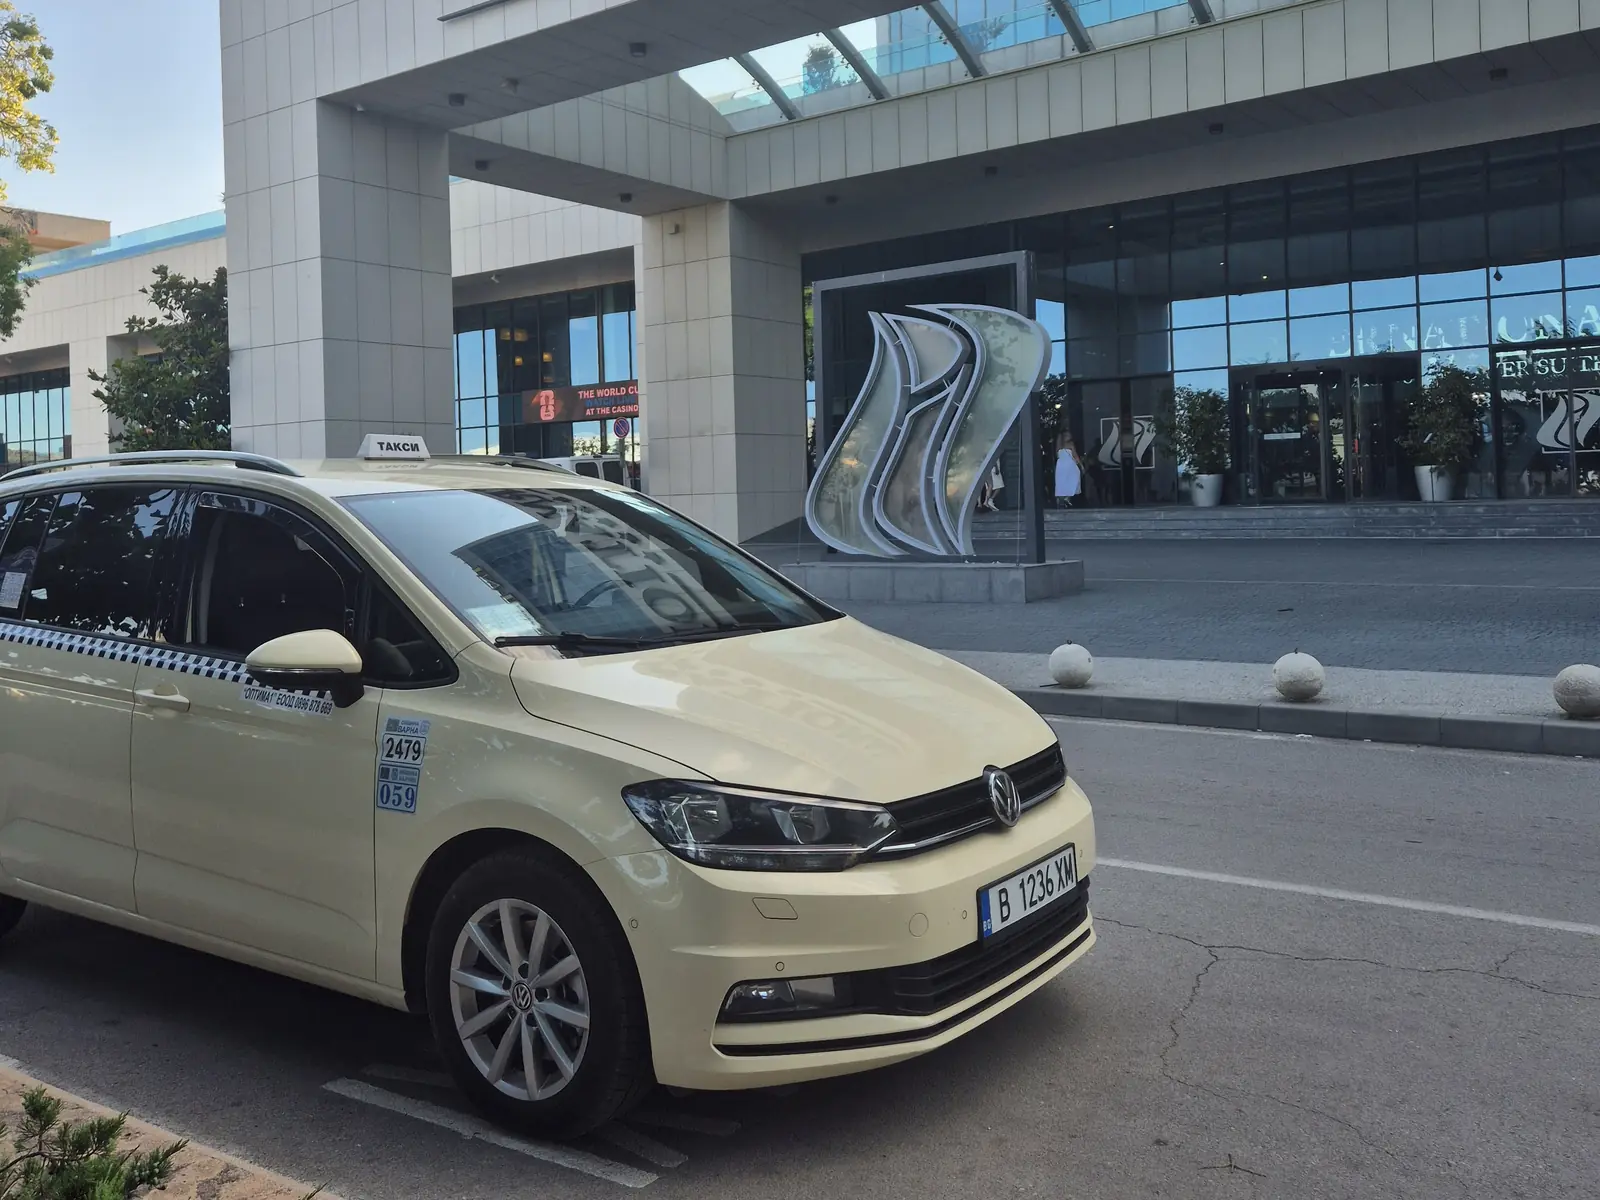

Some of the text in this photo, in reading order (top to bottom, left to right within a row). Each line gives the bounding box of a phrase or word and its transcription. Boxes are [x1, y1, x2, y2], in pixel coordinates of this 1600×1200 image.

[577, 390, 595, 400] THE
[596, 387, 626, 397] WORLD
[586, 404, 638, 416] AT THE CASINO
[377, 441, 420, 452] ТАКСИ
[275, 693, 296, 708] ЕООД
[385, 737, 421, 761] 2479
[380, 783, 415, 808] 059
[998, 853, 1074, 923] B 1236 XM
